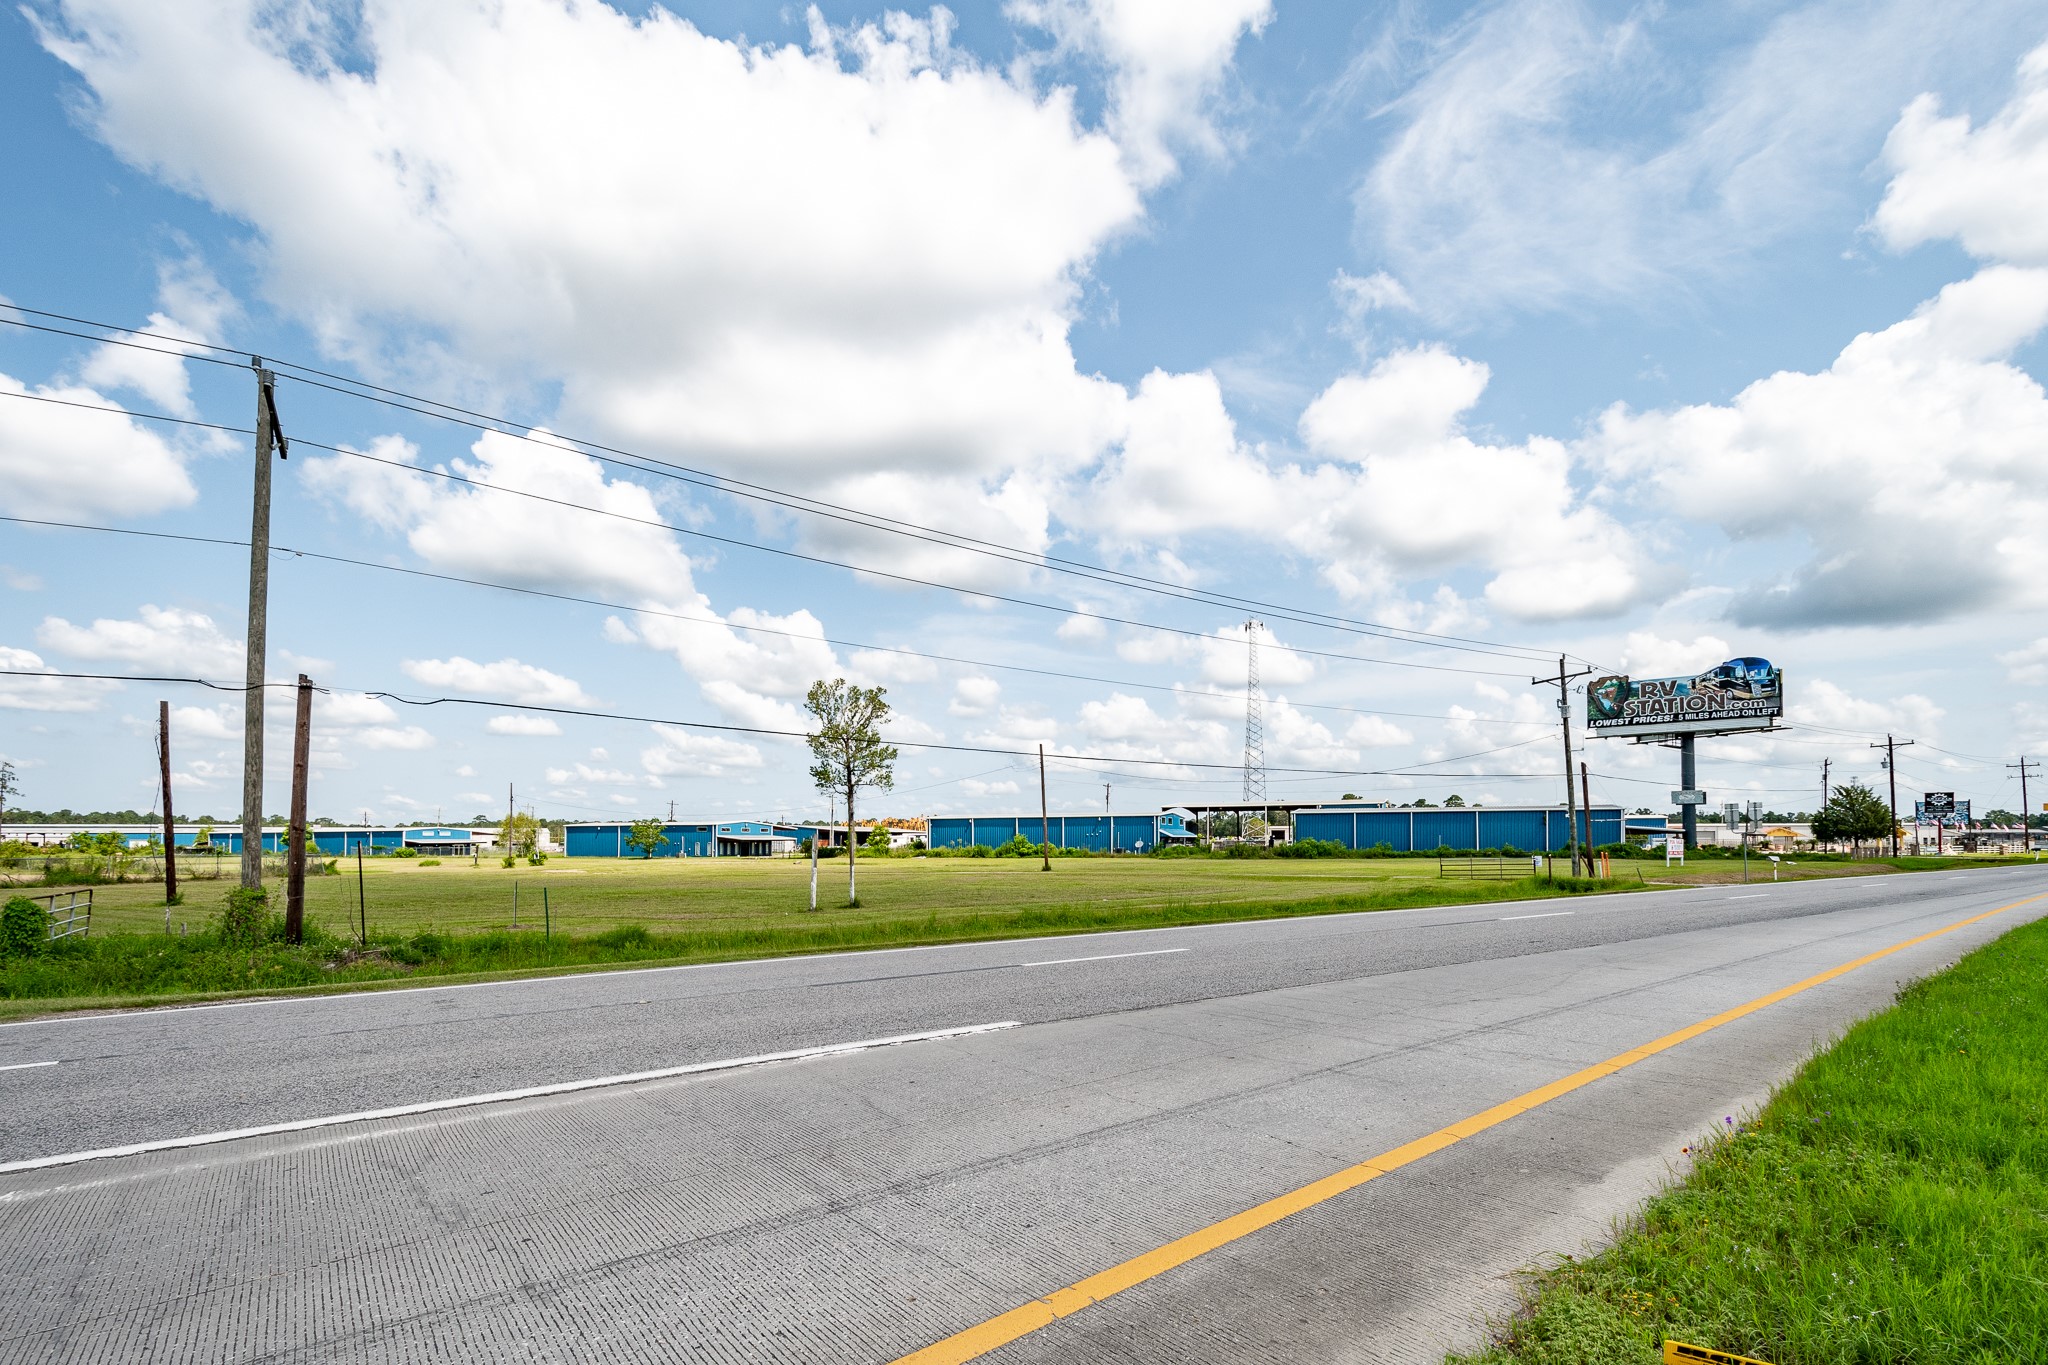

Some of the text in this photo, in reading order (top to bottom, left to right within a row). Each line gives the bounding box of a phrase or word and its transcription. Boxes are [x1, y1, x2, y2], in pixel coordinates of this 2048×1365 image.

[1639, 680, 1677, 699] RV
[1590, 717, 1631, 727] LOWEST
[1632, 714, 1674, 724] PRICES!
[1678, 713, 1684, 721] 5
[1685, 712, 1710, 720] MILES
[1711, 709, 1740, 719] AHEAD
[1757, 707, 1779, 715] LEFT
